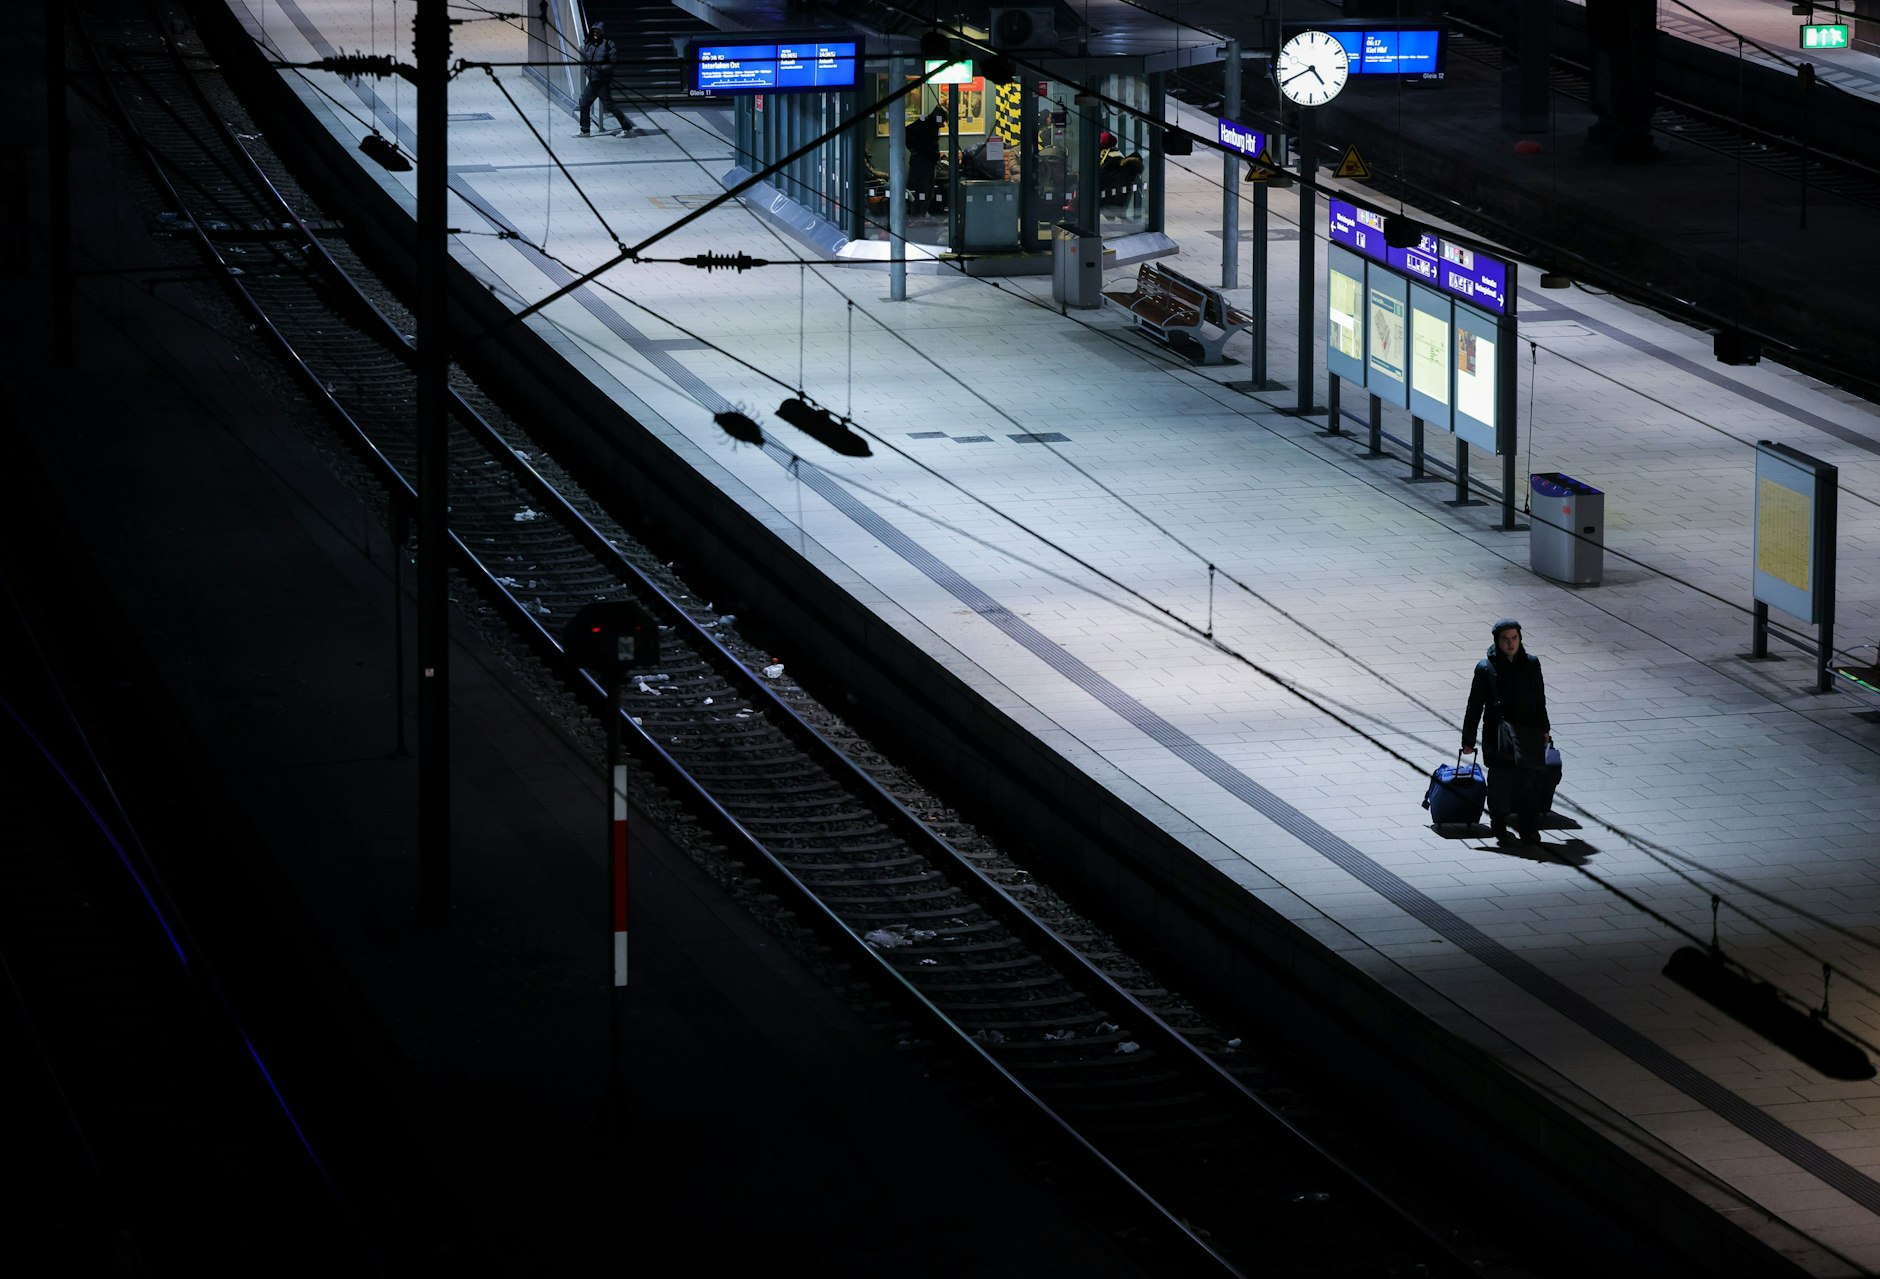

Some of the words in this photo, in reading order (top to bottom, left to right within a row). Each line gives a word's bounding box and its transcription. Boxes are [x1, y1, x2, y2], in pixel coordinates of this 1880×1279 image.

[1377, 46, 1388, 54] Hbf
[729, 61, 740, 69] Ost
[689, 89, 705, 97] Gleis
[1220, 123, 1245, 153] Hamburg
[1245, 133, 1256, 153] Hbf
